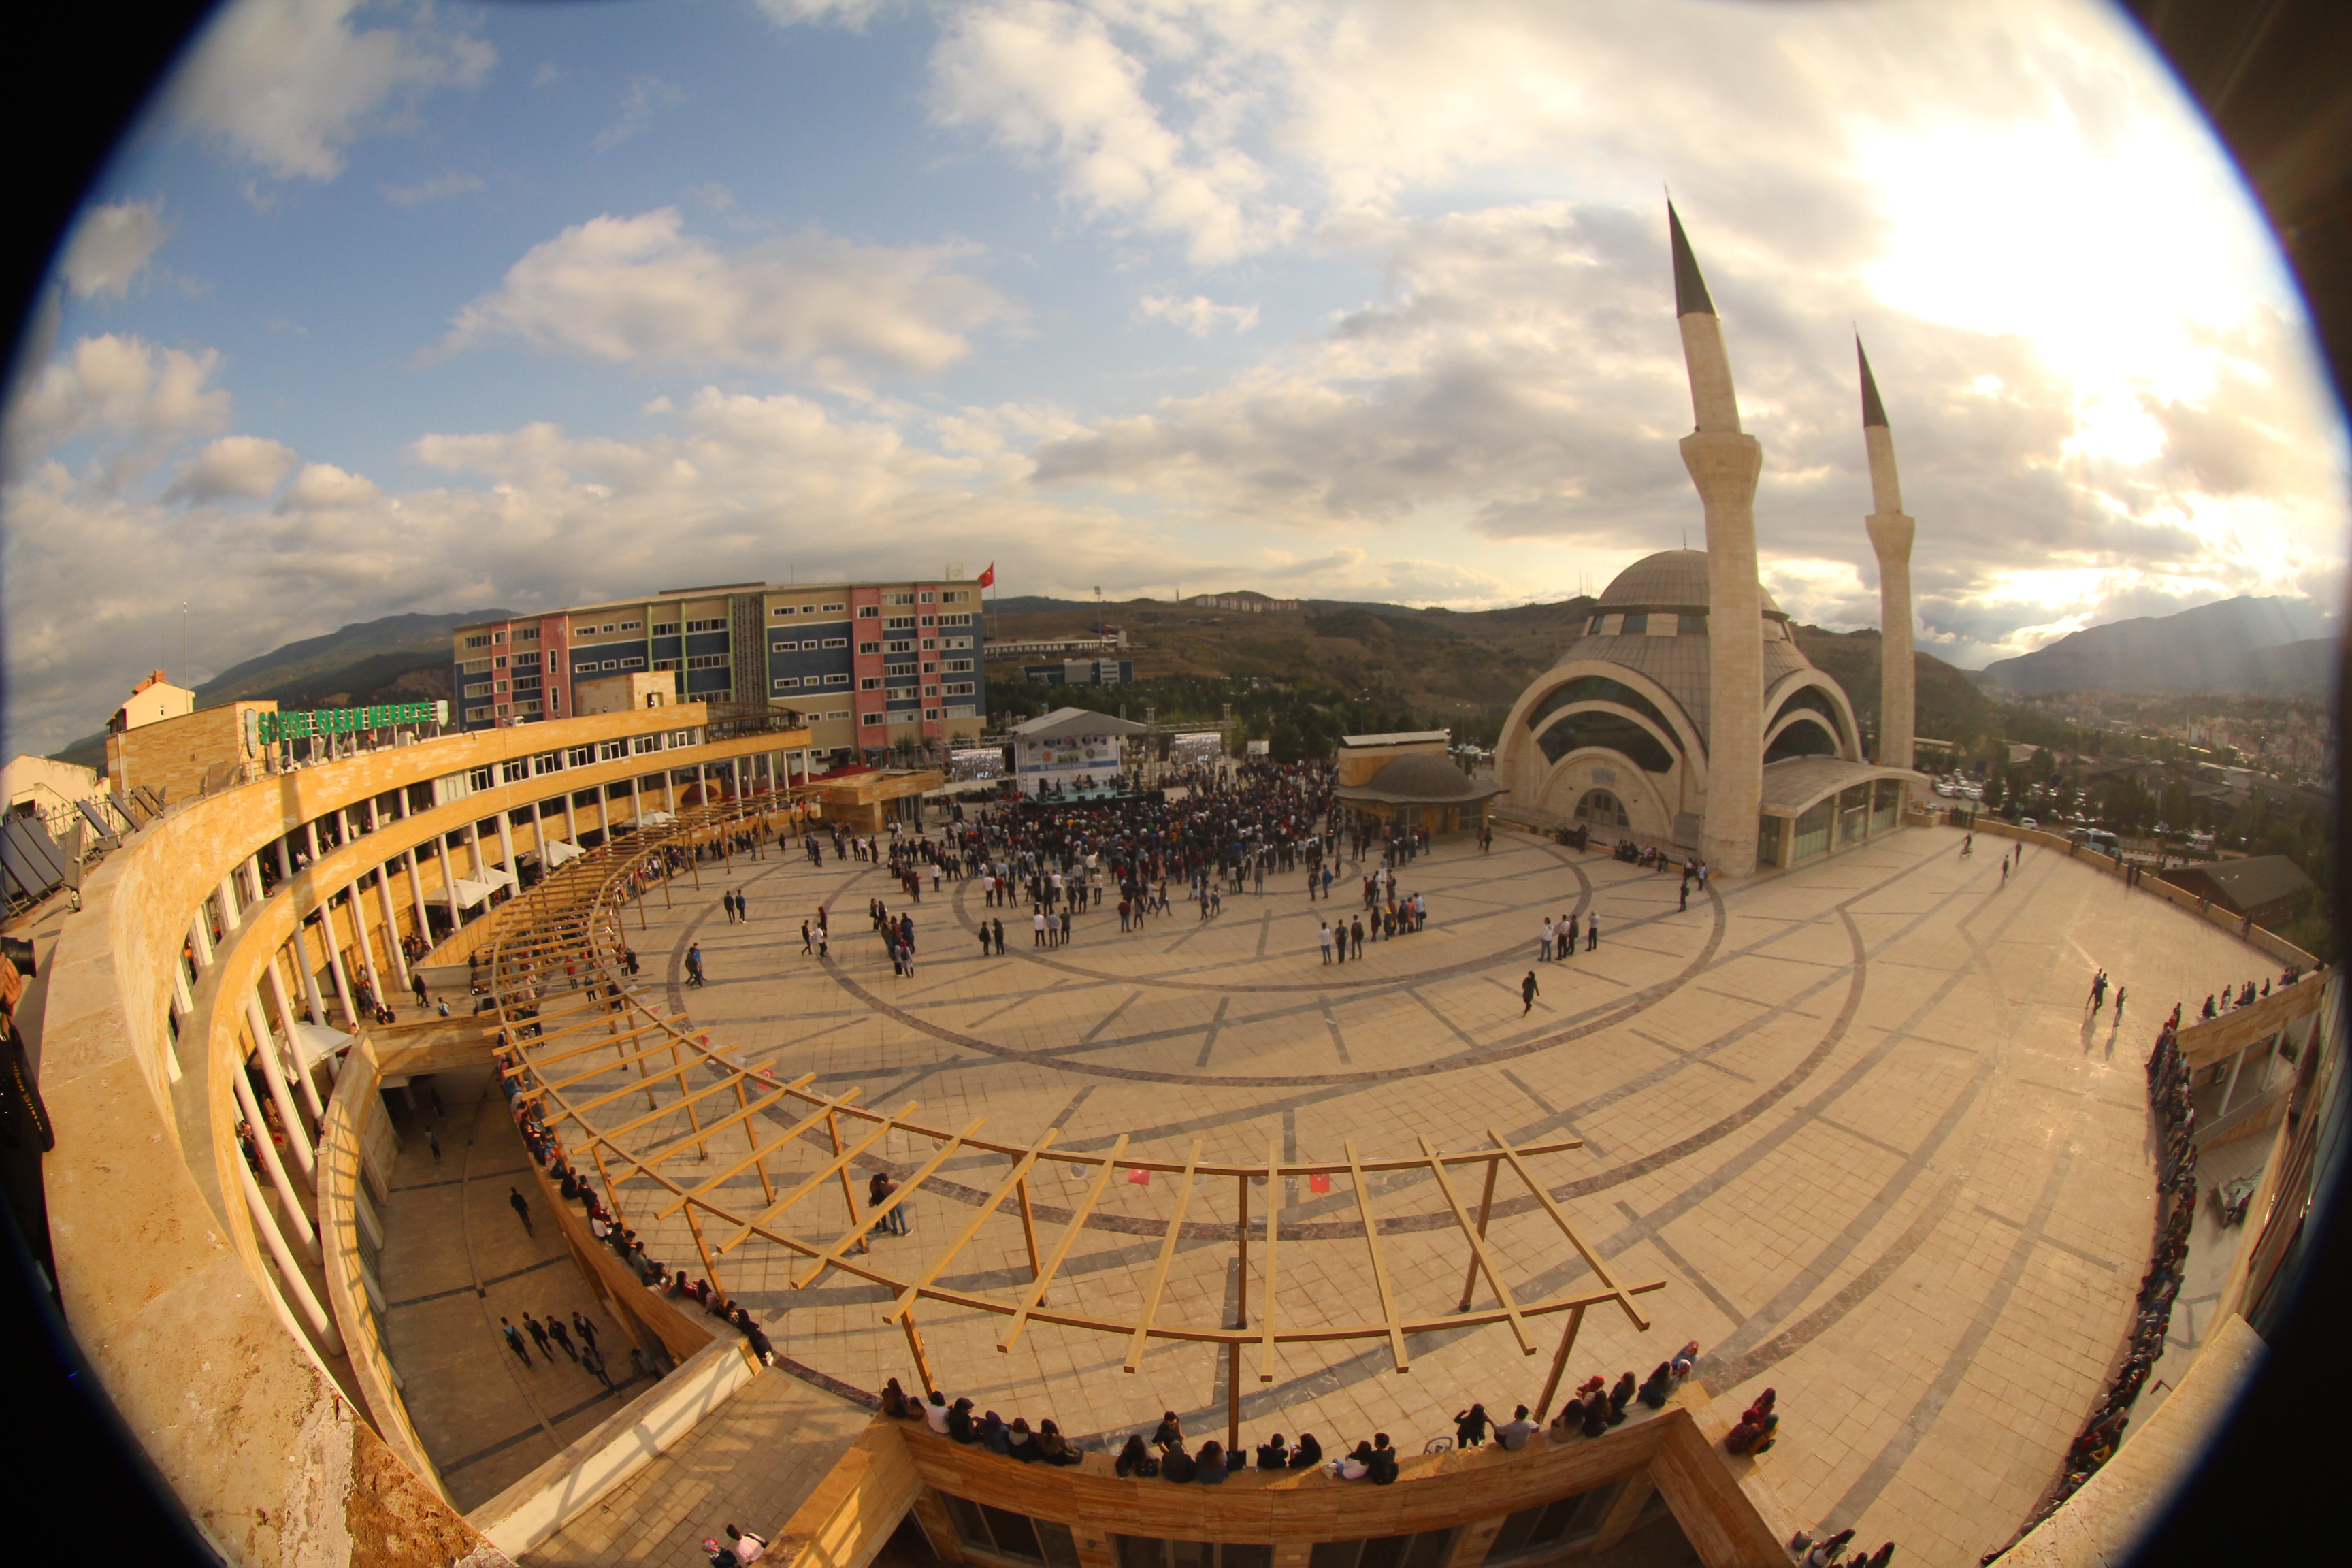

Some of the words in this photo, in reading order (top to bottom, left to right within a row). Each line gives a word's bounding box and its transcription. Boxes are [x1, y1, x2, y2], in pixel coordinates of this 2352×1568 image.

[259, 710, 312, 744] SOSYAL
[315, 707, 363, 740] YAŞAM
[369, 697, 431, 730] MERKEZİ
